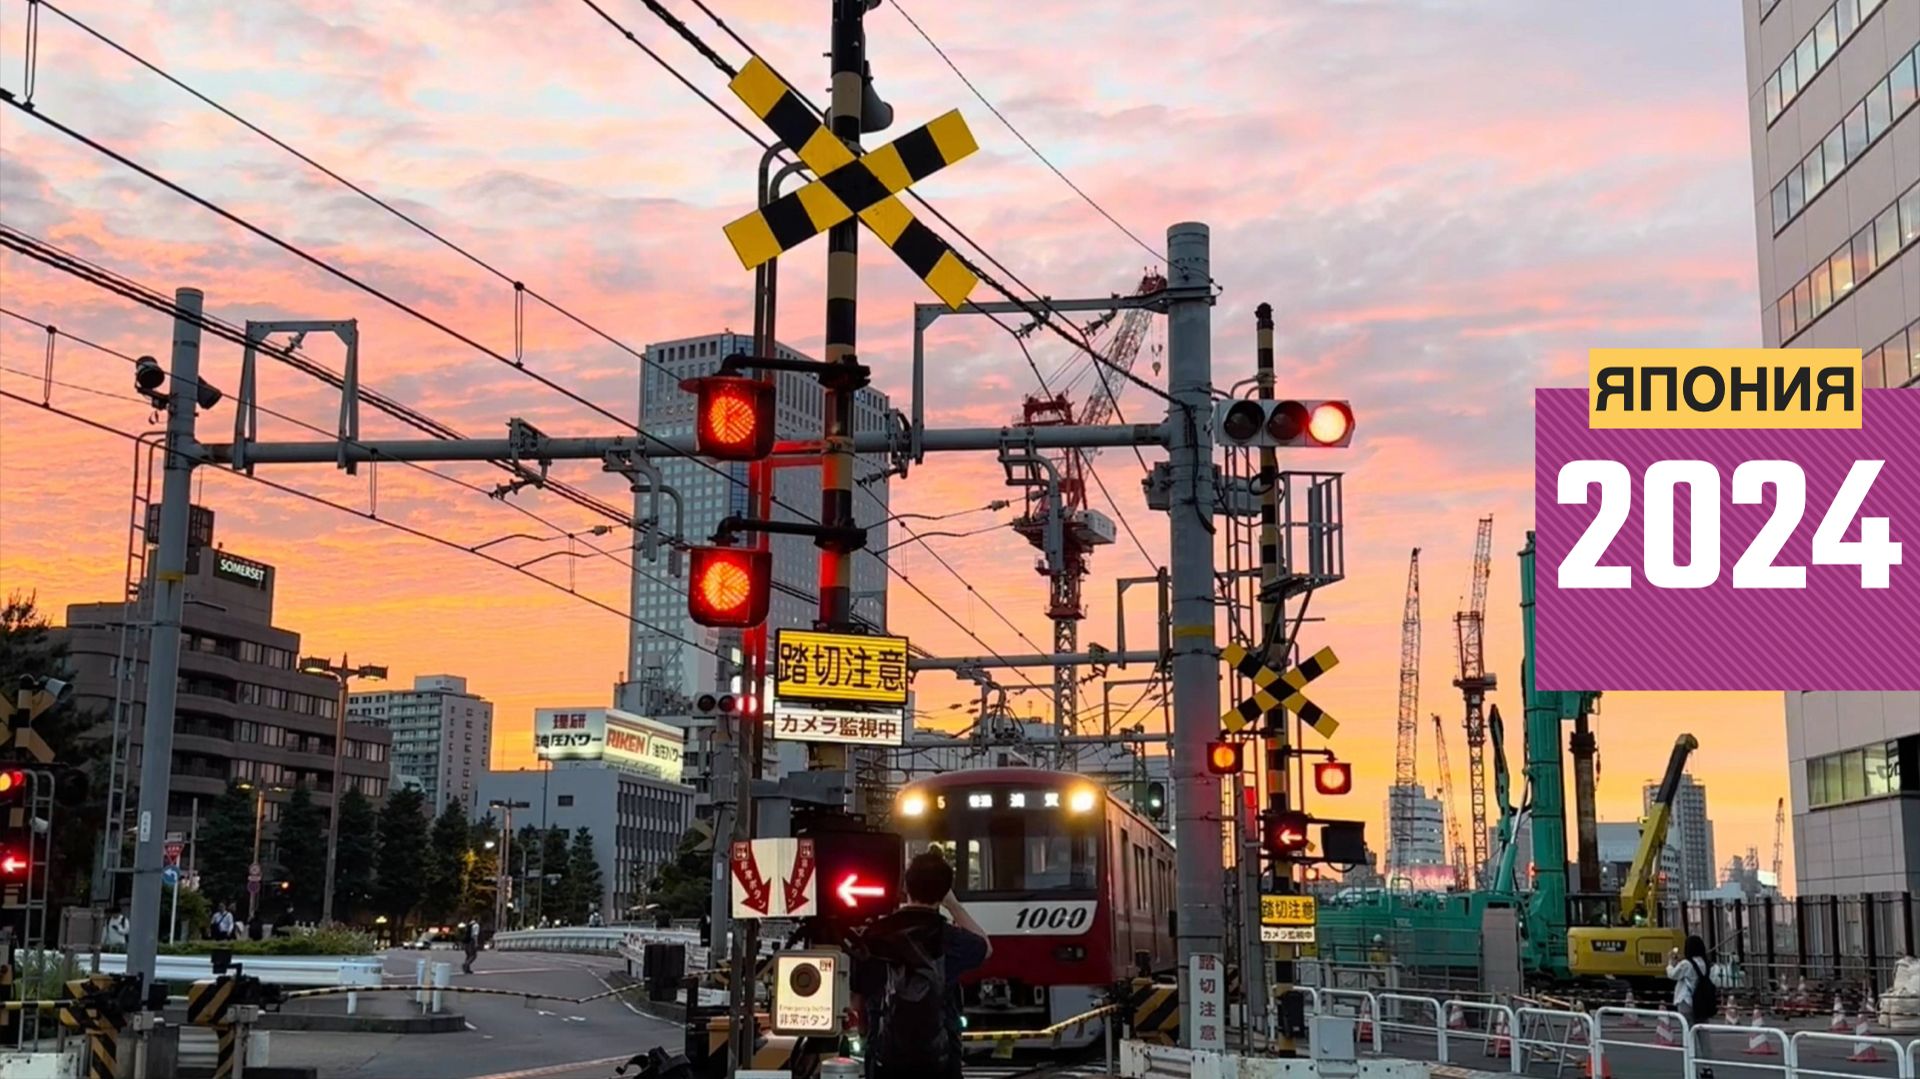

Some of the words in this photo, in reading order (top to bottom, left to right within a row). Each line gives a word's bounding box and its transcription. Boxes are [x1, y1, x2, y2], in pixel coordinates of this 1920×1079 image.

[220, 559, 264, 580] SOMERSET
[779, 643, 904, 691] 踏切注意
[553, 714, 586, 729] 理研
[781, 714, 896, 738] カメラ監視中
[606, 728, 645, 754] RIKEN
[1016, 907, 1087, 929] 1000
[1262, 900, 1313, 920] 踏切注意
[1199, 955, 1217, 1041] 踏切注意
[780, 1013, 830, 1026] 非常ボタン
